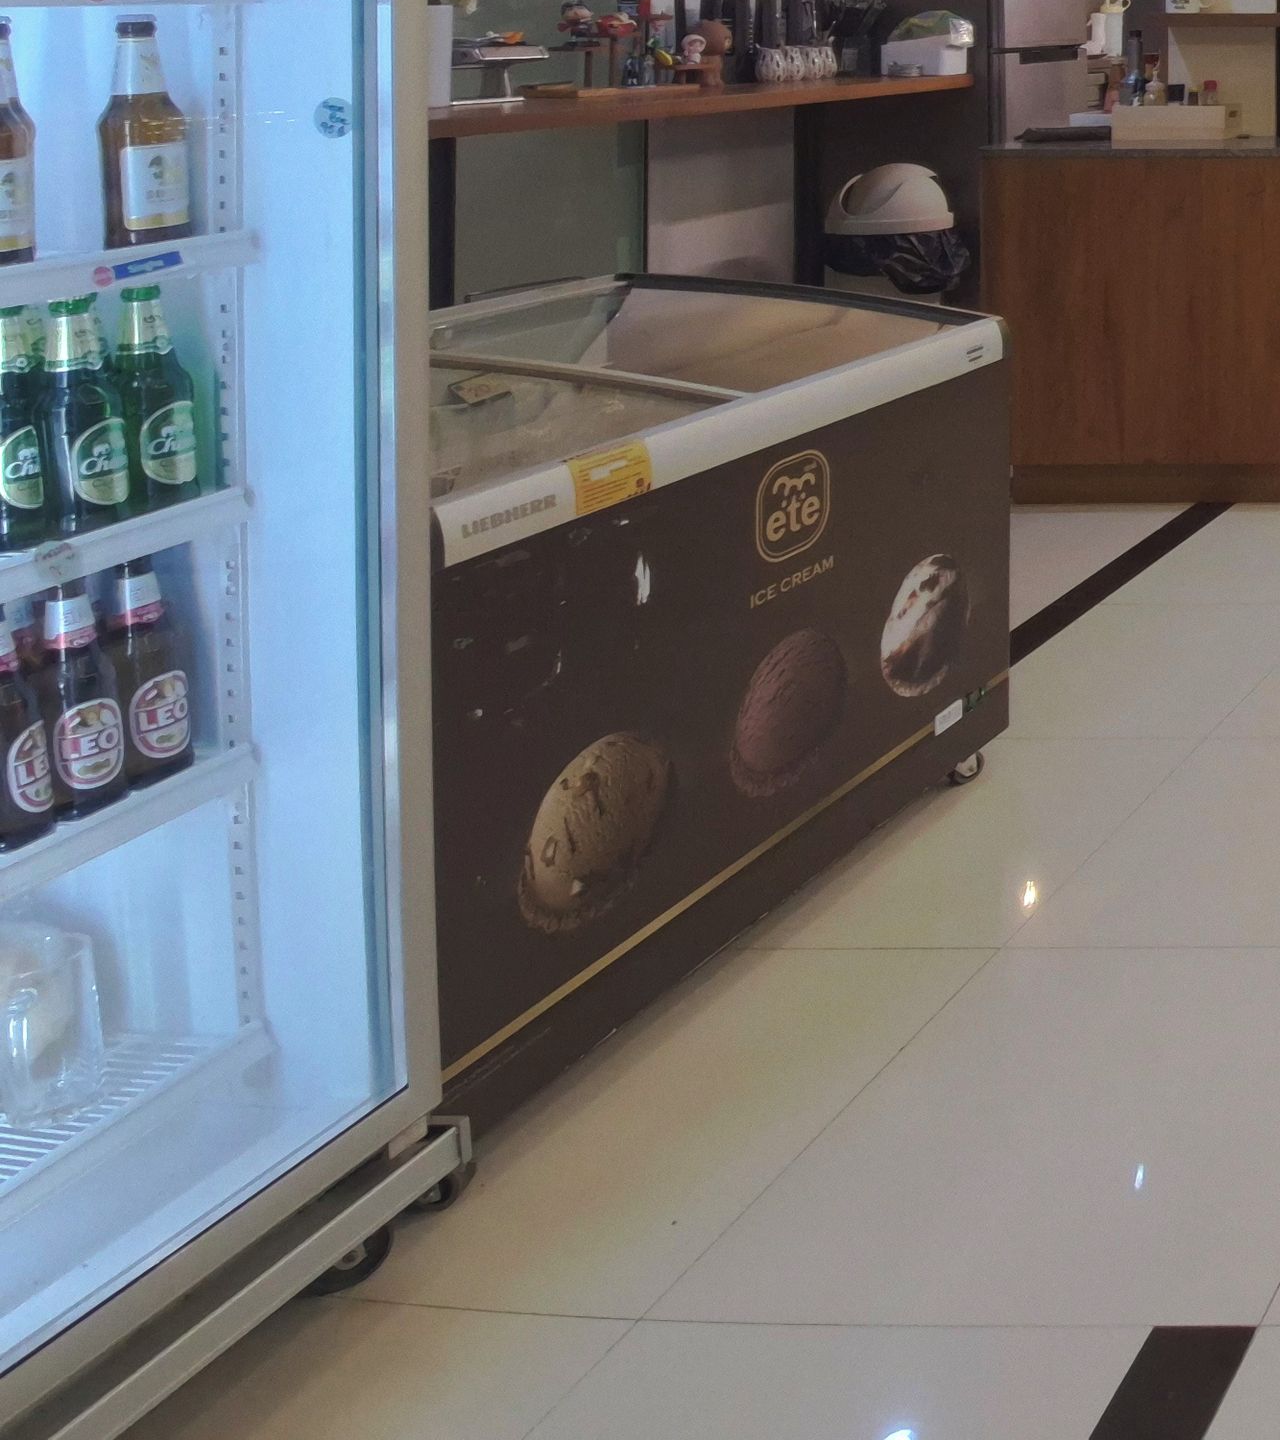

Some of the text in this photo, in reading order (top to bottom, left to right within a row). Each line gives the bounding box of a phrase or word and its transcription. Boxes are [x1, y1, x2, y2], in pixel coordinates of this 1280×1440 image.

[461, 494, 557, 539] LIEBHERR
[750, 555, 834, 609] ICE CREAM
[138, 697, 189, 732] LEO
[61, 728, 121, 760] LEO
[16, 754, 49, 786] LE
